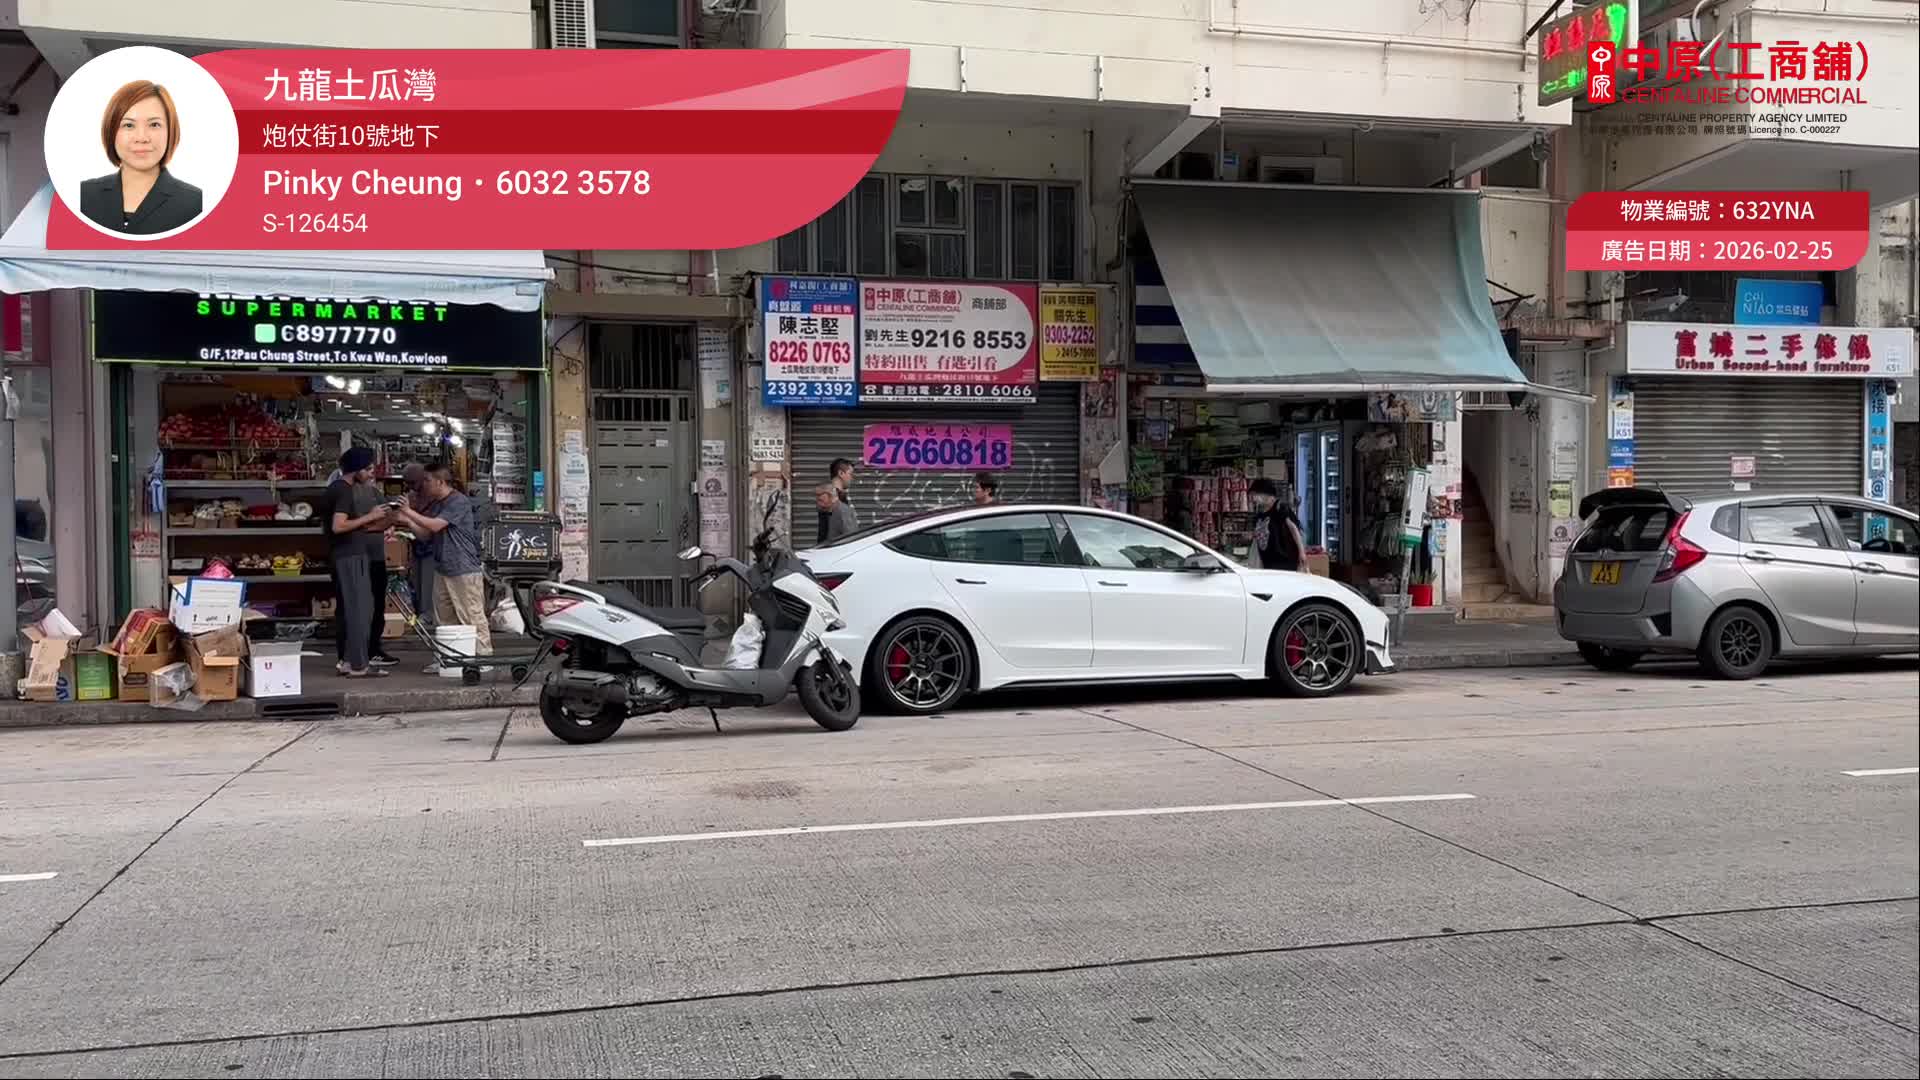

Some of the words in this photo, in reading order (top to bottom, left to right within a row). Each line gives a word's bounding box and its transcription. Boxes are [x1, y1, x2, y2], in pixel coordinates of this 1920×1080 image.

[197, 300, 448, 321] SUPERMARKET
[915, 305, 961, 313] COMMERCIAL
[281, 324, 397, 345] 68977770
[779, 316, 840, 336] 陳志堅
[1044, 324, 1095, 344] 9303-2252
[864, 329, 909, 342] 劉先生
[911, 329, 966, 348] 9216
[973, 330, 1026, 350] 8553
[1675, 329, 1871, 361] 富城二手傢俬
[259, 350, 294, 363] Chung
[350, 351, 372, 362] Kwa
[769, 341, 808, 363] 8226
[812, 341, 851, 364] 0763
[864, 354, 928, 371] 特約出售
[937, 355, 998, 371] 有匙引看
[1675, 358, 1714, 370] Urban
[1722, 359, 1807, 371] Second-hand
[1814, 360, 1870, 373] furniture
[767, 382, 808, 395] 2392
[814, 383, 853, 395] 3392
[943, 384, 984, 397] 2810
[991, 385, 1033, 397] 6066
[868, 438, 1007, 466] 27660818
